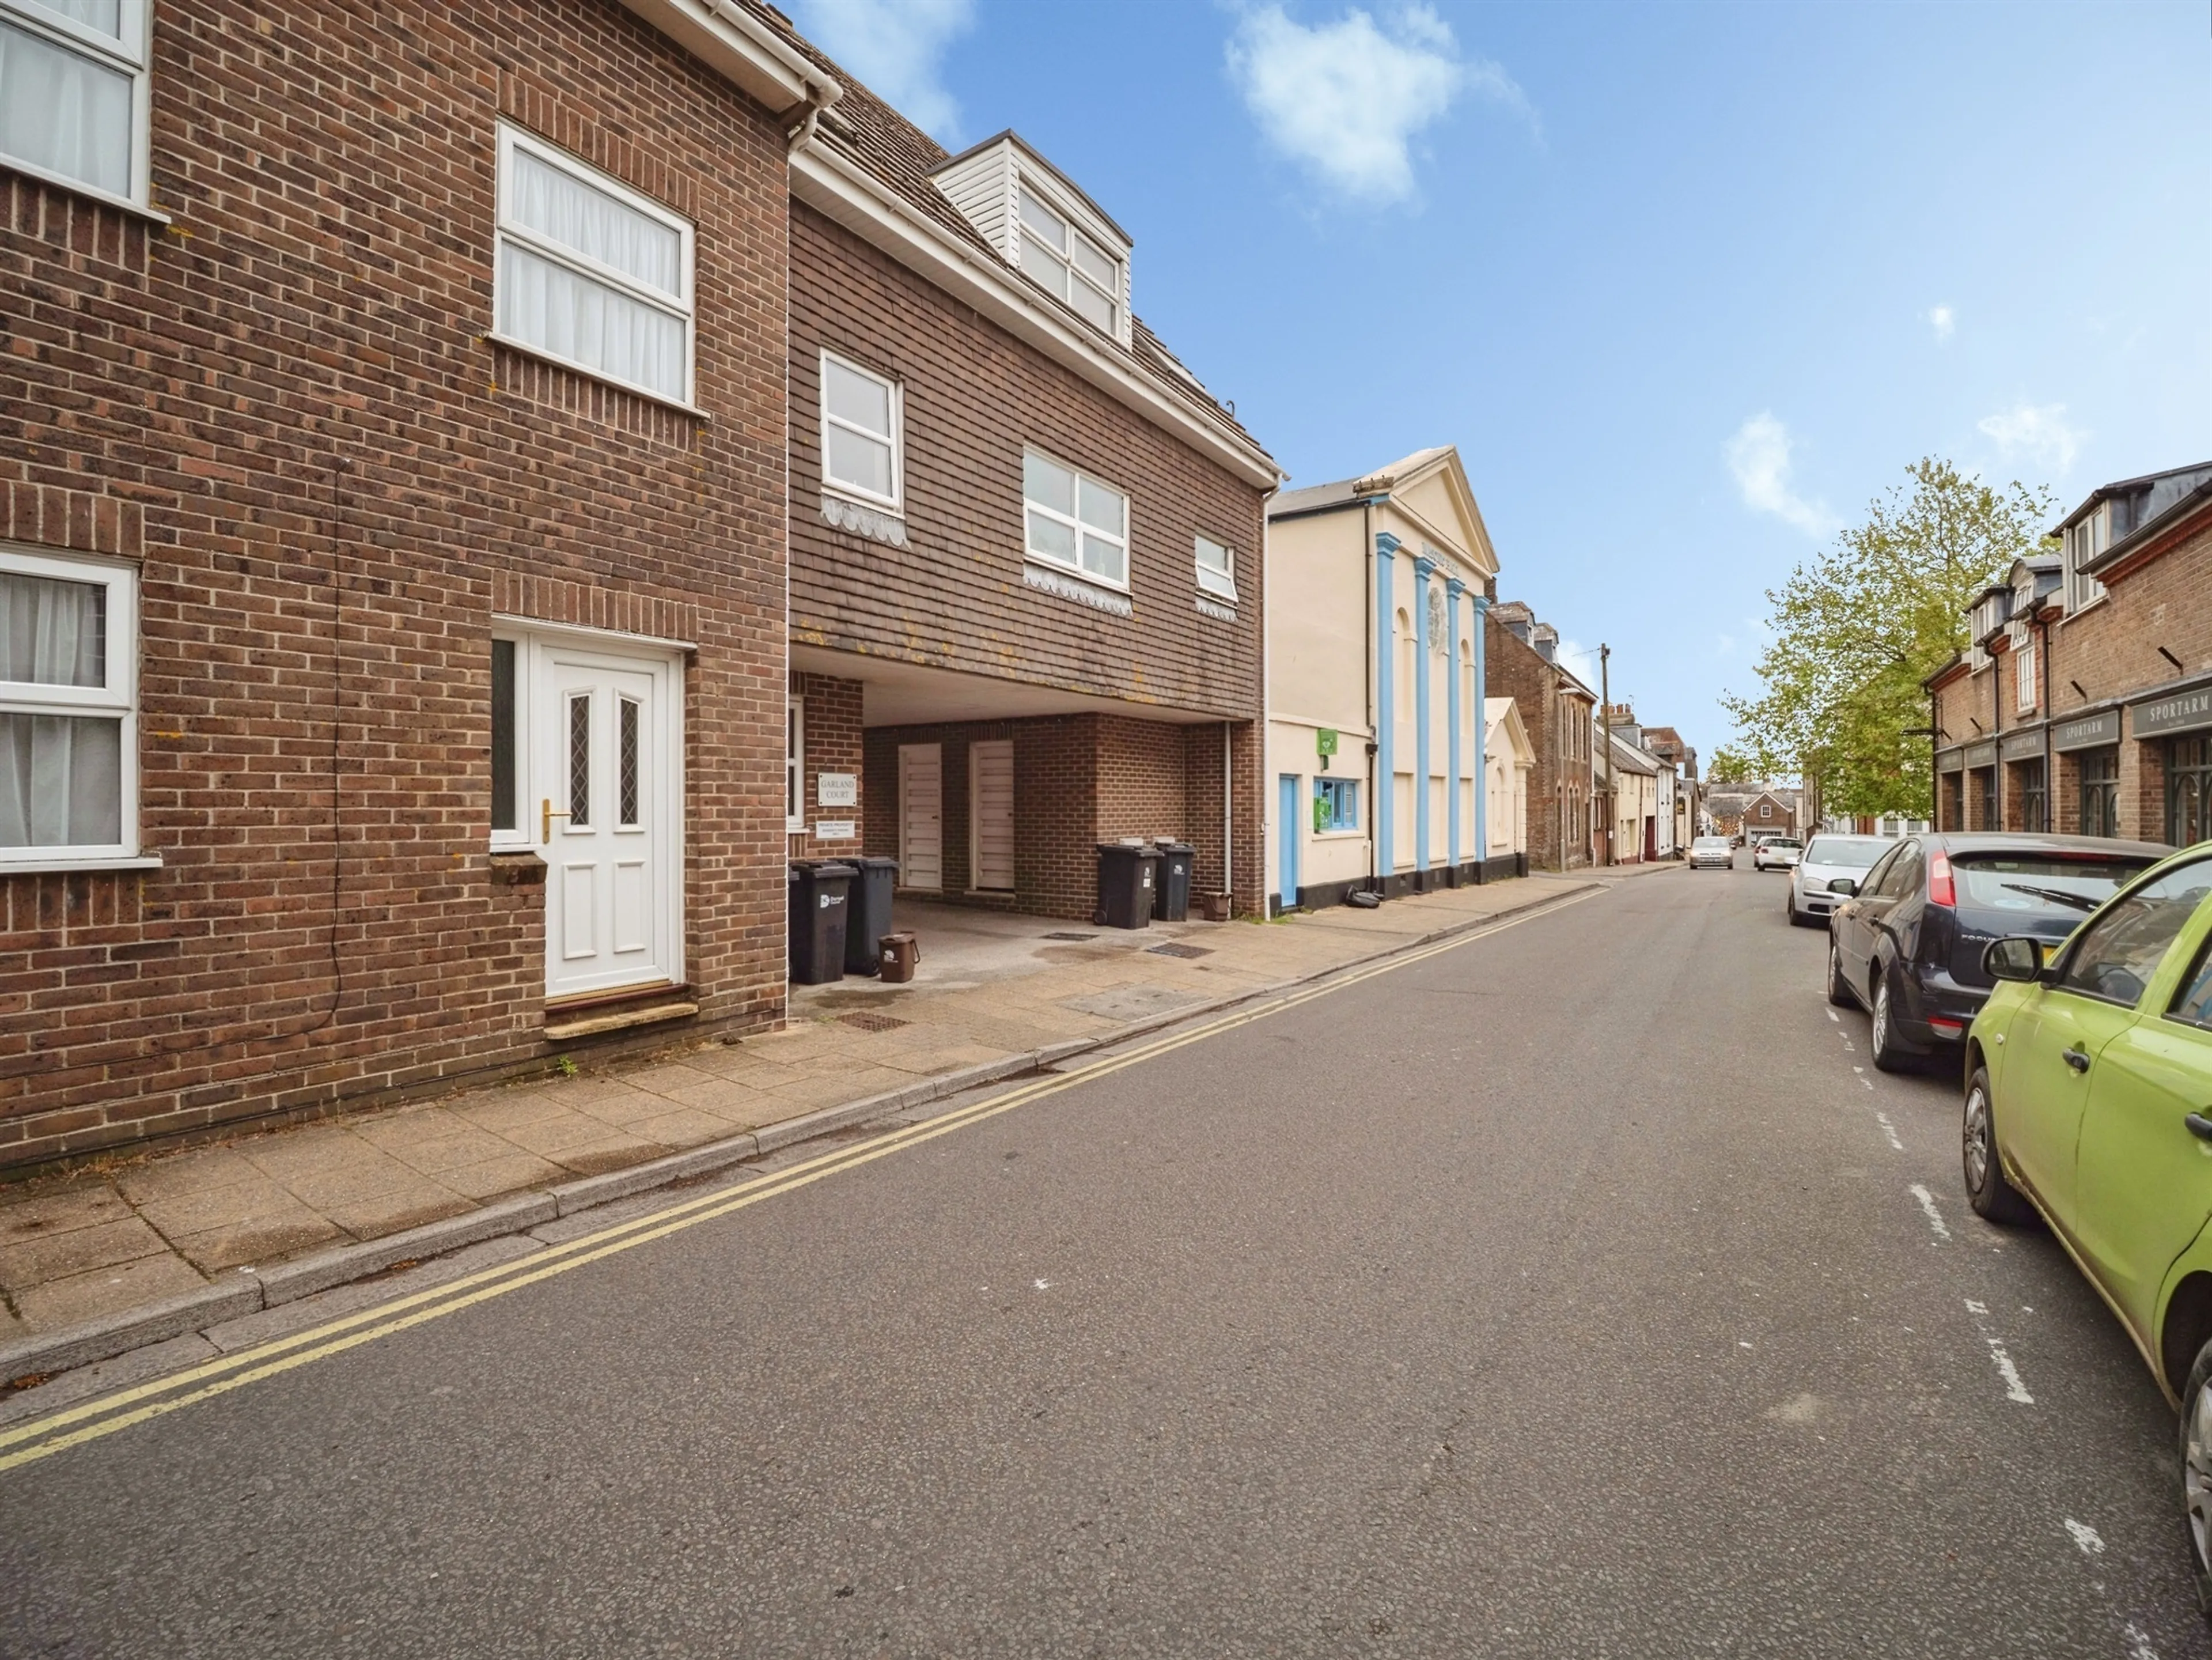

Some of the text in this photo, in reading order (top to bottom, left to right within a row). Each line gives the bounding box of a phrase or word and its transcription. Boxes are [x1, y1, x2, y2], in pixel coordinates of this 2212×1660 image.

[2150, 695, 2209, 722] SPORTARM
[2066, 720, 2102, 739] SPORTARM
[821, 780, 854, 788] GARLAND
[826, 791, 849, 799] COURT
